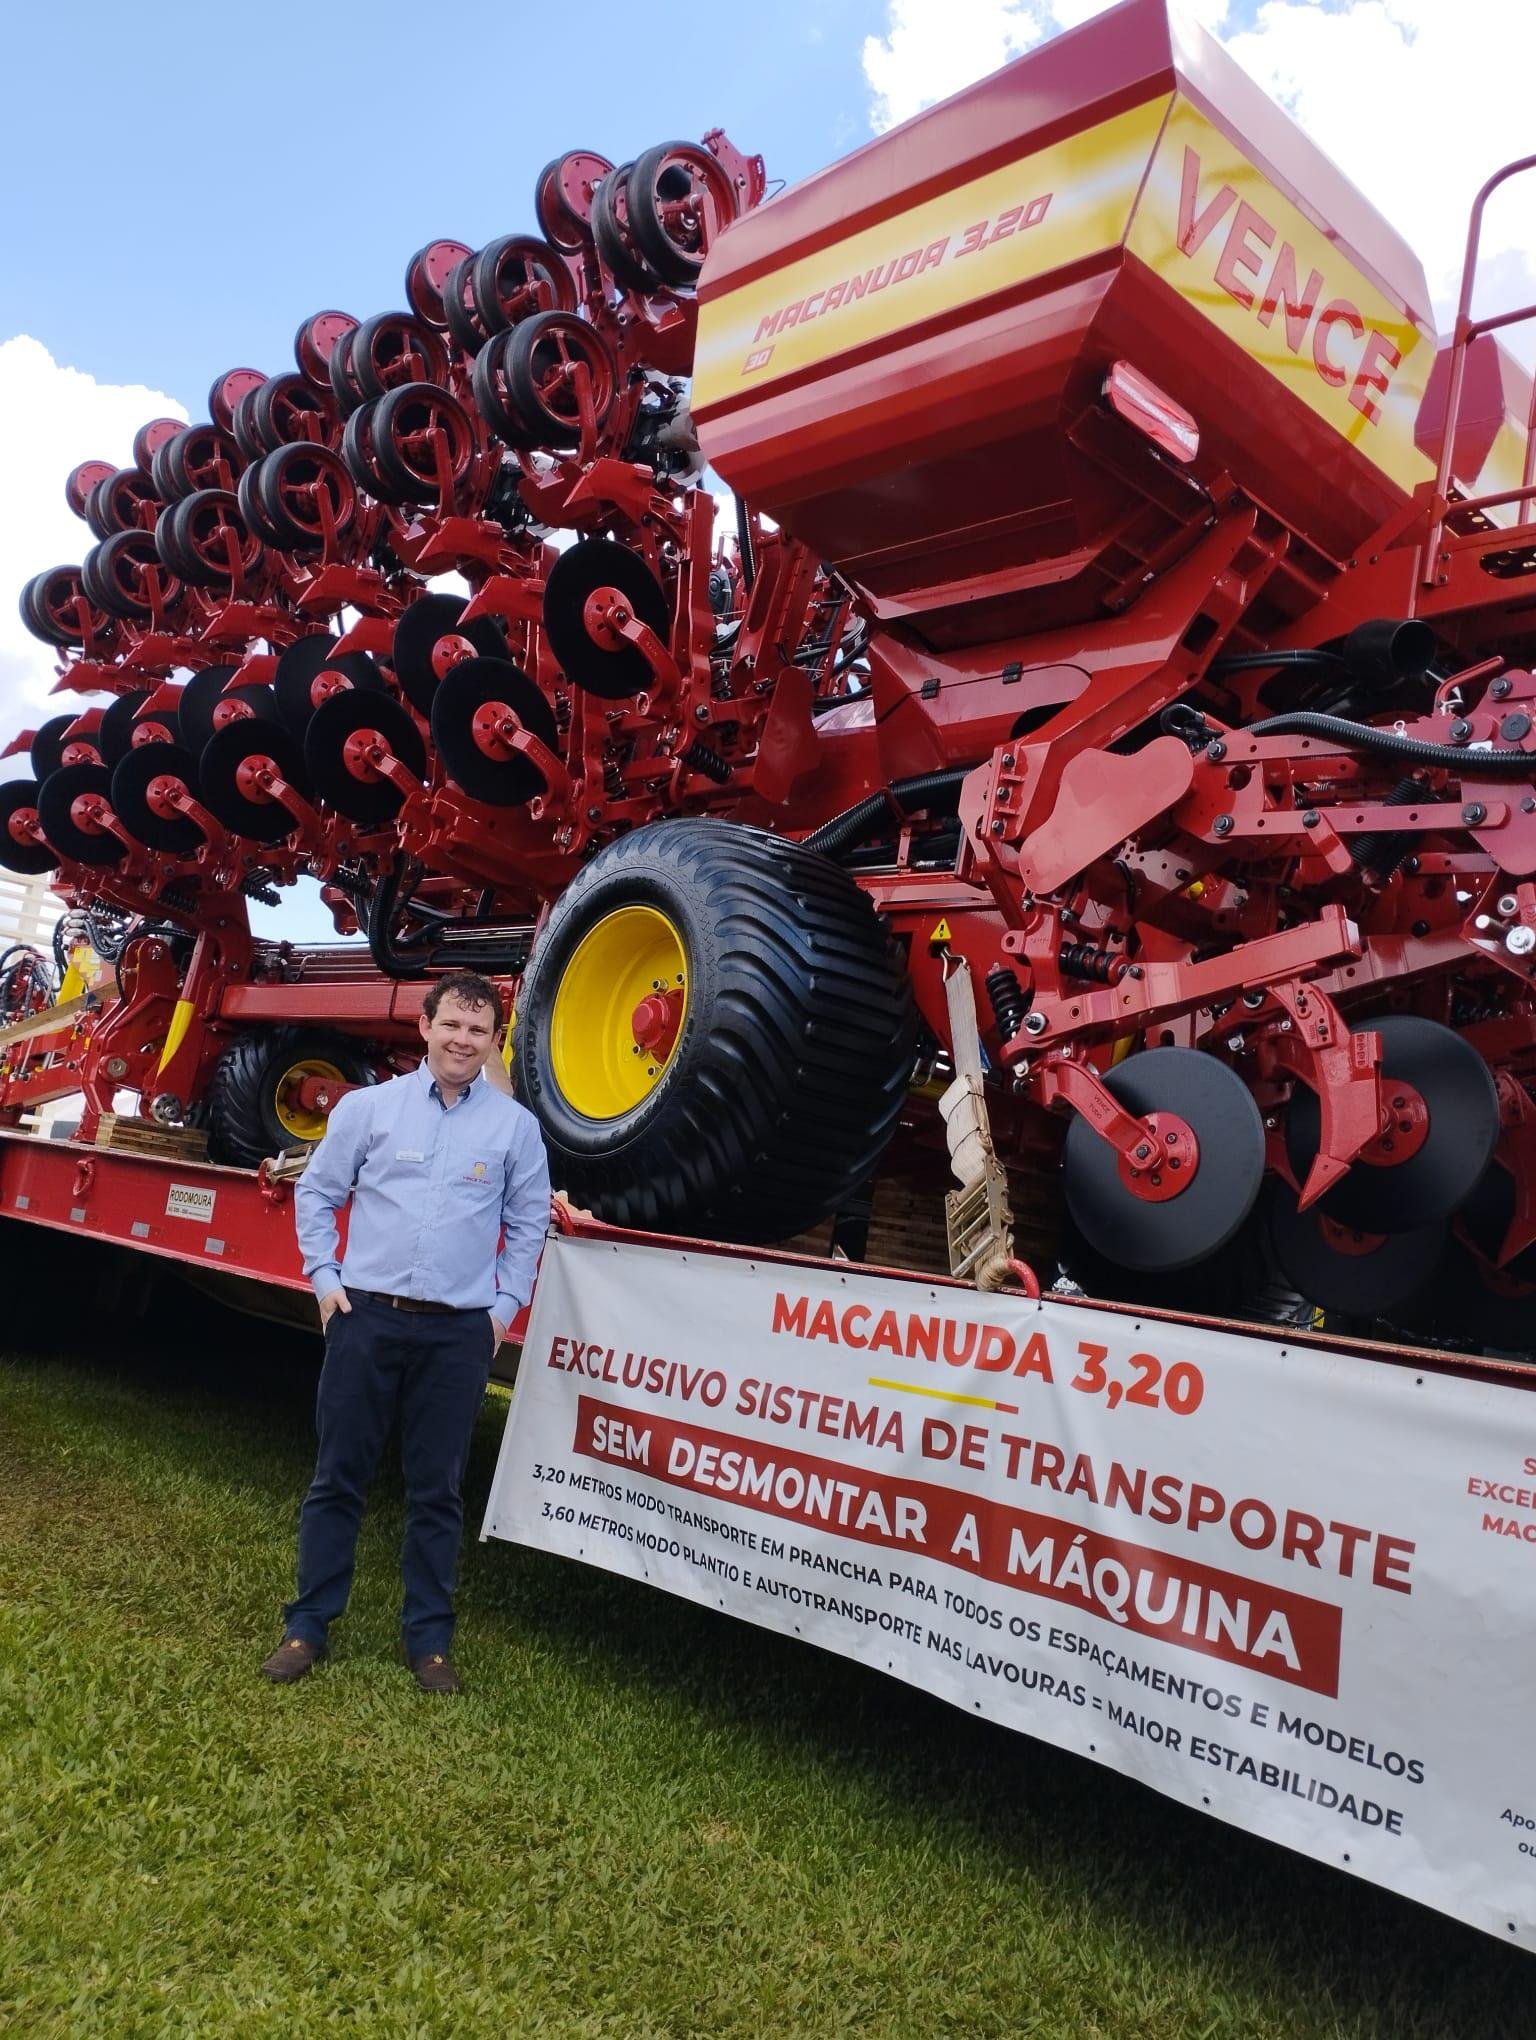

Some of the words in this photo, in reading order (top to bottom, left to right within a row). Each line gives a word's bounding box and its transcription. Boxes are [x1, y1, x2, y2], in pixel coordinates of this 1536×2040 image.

[752, 236, 950, 344] MACANUDA
[954, 193, 1053, 258] 3,20
[1177, 144, 1402, 426] VENCE
[170, 1190, 212, 1206] RODOMOURA
[548, 1336, 727, 1408] EXCLUSIVO
[735, 1378, 904, 1453] SISTEMA
[921, 1418, 989, 1470] DE
[1001, 1434, 1415, 1594] TRANSPORTE
[772, 1293, 1053, 1382] MACANUDA
[1070, 1341, 1205, 1416] 3,20
[533, 1464, 565, 1483] 3,20
[569, 1473, 621, 1500] METROS
[627, 1489, 665, 1514] MODO
[667, 1504, 756, 1549] TRANSPORTE
[761, 1537, 784, 1559] EM
[790, 1546, 882, 1586] PRANCHA
[890, 1572, 937, 1604] PARA
[945, 1590, 1002, 1629] TODOS
[1009, 1617, 1040, 1641] OS
[1049, 1628, 1240, 1716] ESPAÇAMENTOS
[1250, 1703, 1269, 1728] E
[1278, 1712, 1424, 1783] MODELOS
[542, 1503, 574, 1522] 3,60
[579, 1512, 633, 1541] METROS
[637, 1530, 679, 1556] MODO
[683, 1546, 738, 1581] PLANTIO
[744, 1571, 751, 1587] E
[756, 1577, 922, 1644] AUTOTRANSPORTE
[928, 1631, 961, 1660] NAS
[967, 1648, 1085, 1705] LAVOURAS
[1109, 1701, 1181, 1751] MAIOR
[1191, 1737, 1403, 1835] ESTABILIDADE
[592, 1416, 651, 1465] SEM
[668, 1438, 926, 1543] DESMONTAR
[951, 1514, 980, 1562] A
[1008, 1528, 1300, 1670] MÁQUINA
